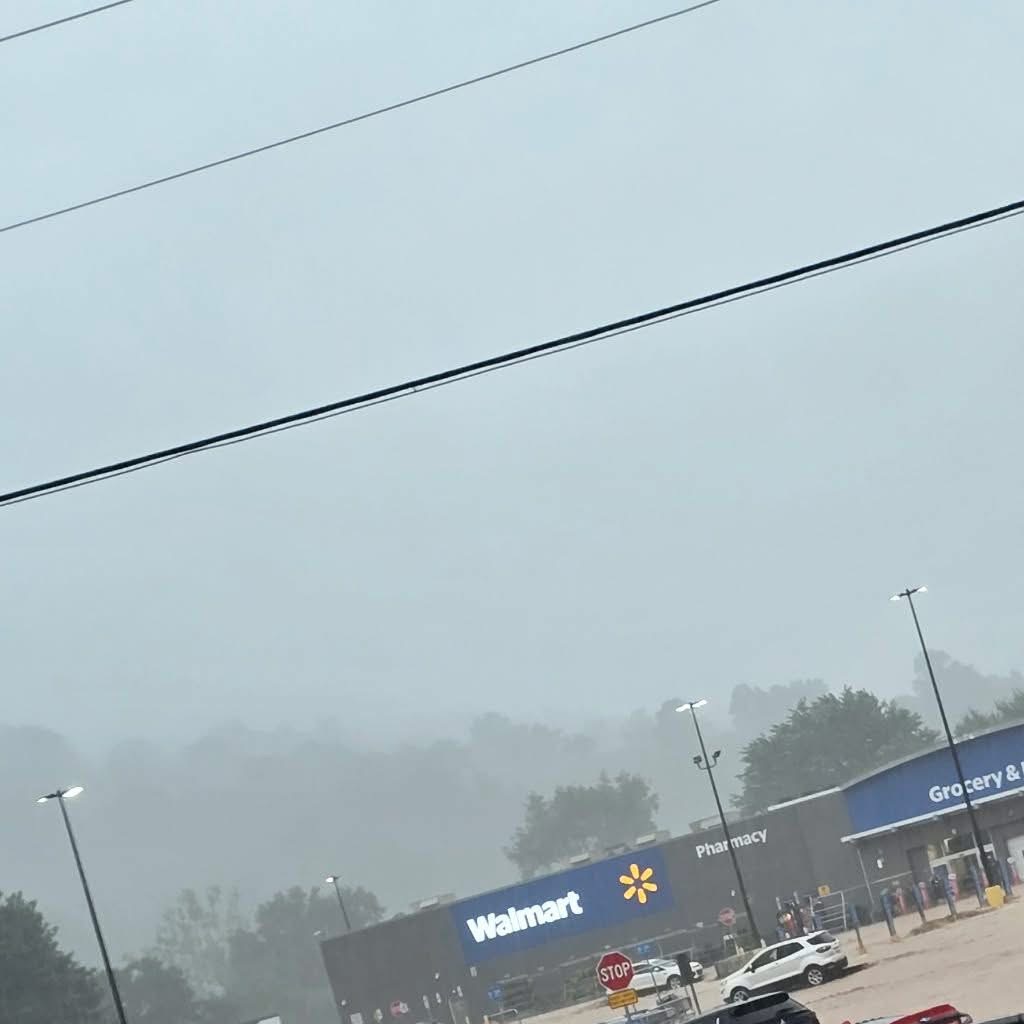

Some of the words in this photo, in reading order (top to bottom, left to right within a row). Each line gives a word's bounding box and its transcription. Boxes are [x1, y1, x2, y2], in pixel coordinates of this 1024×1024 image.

[929, 770, 1002, 803] Grocery
[1005, 764, 1021, 782] &
[695, 828, 767, 859] Pharmacy
[466, 890, 584, 943] Walmart
[600, 961, 630, 983] STOP
